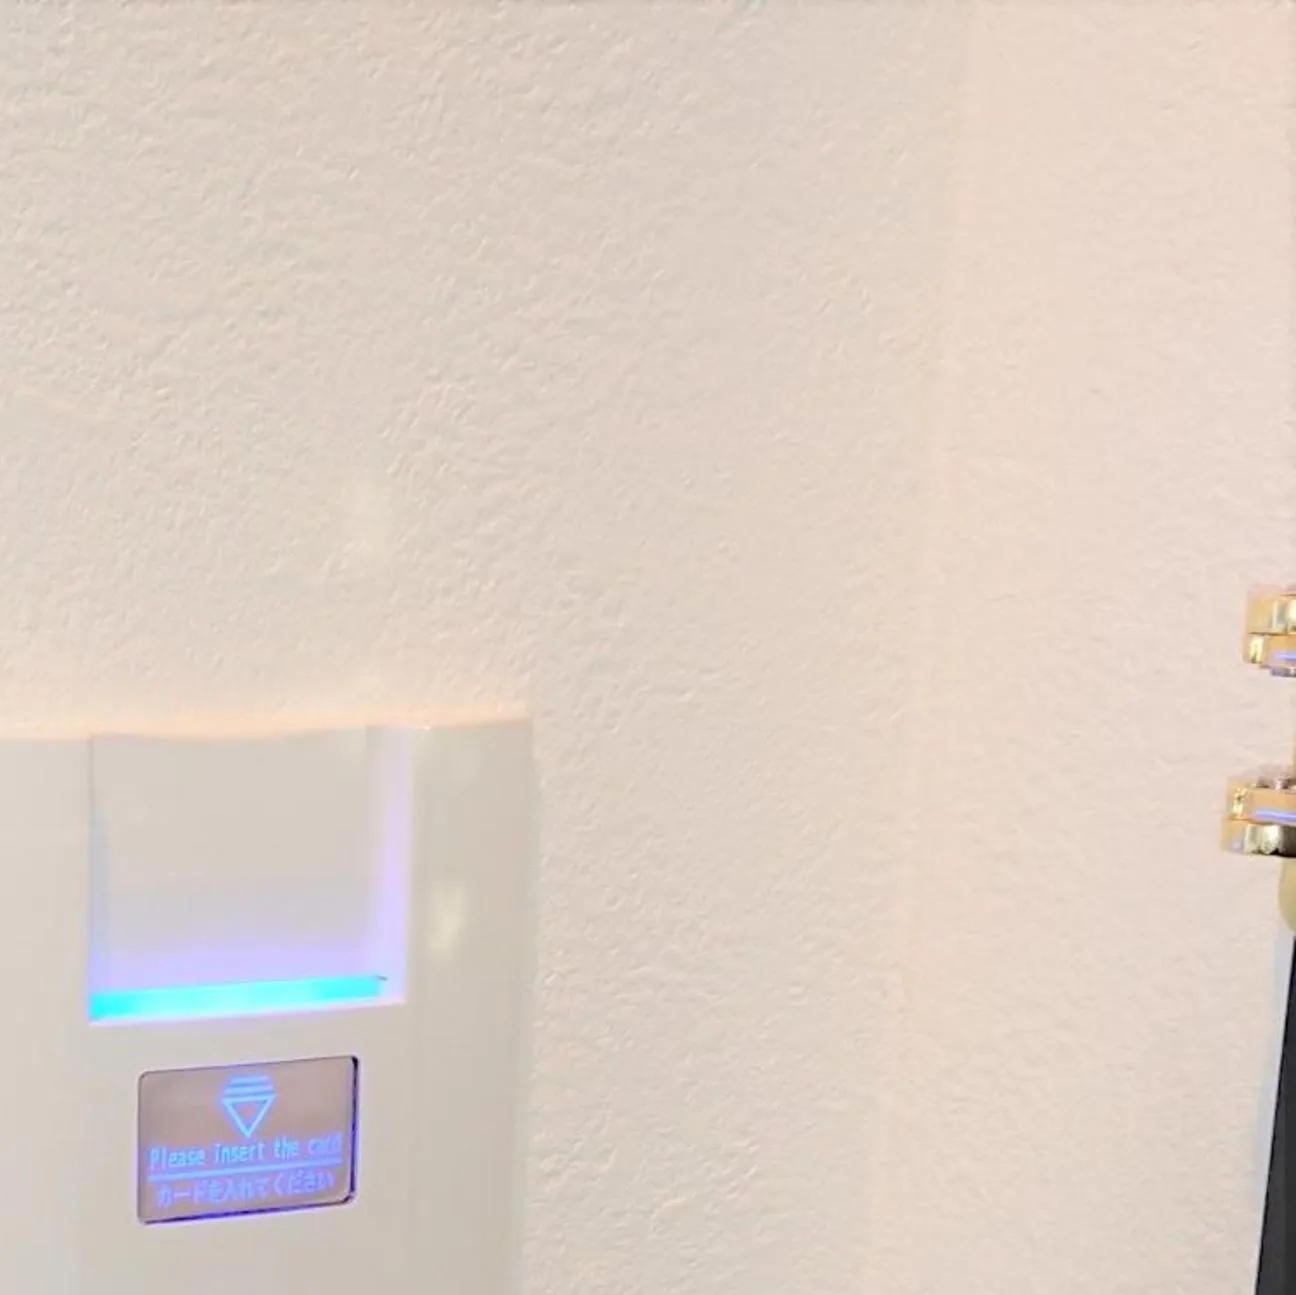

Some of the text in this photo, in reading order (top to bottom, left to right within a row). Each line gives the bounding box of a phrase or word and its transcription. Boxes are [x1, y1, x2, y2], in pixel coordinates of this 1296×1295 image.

[149, 1148, 205, 1169] Please
[215, 1142, 264, 1163] insert
[274, 1136, 299, 1158] the
[157, 1172, 335, 1206] カードを入れてください
